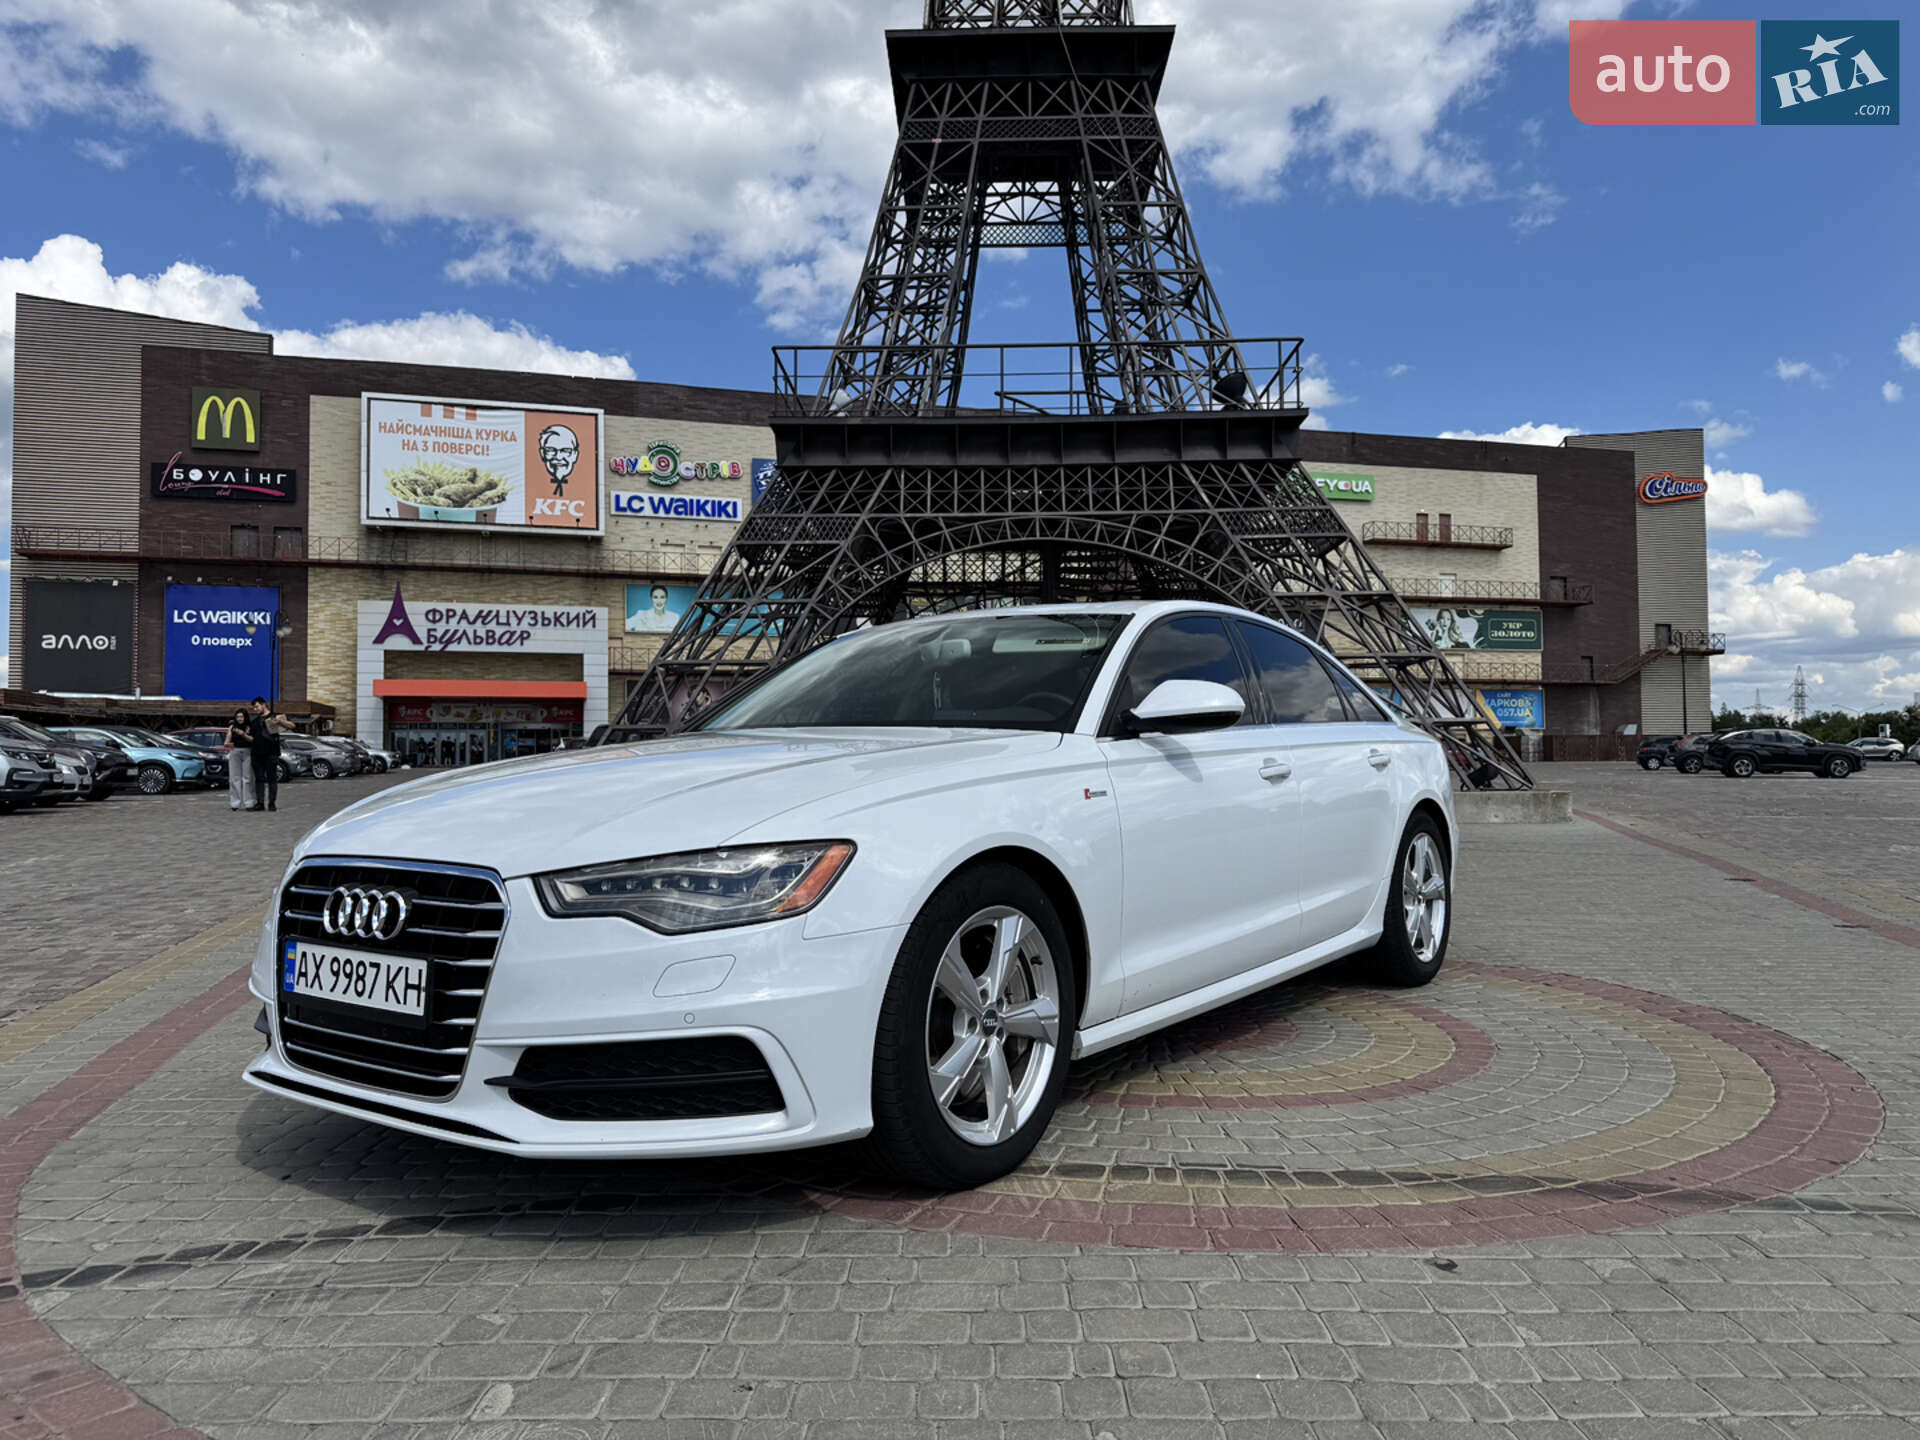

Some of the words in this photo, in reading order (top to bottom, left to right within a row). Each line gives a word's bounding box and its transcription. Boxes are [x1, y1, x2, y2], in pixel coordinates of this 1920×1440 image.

[378, 419, 474, 440] НАЙСМАЧНІША
[476, 428, 518, 442] КУРКА
[401, 439, 419, 452] НА
[421, 440, 429, 452] 3
[432, 441, 491, 456] ПОВЕРСІ!
[172, 468, 287, 485] БОУЛІНГ
[532, 498, 585, 517] KFC
[614, 494, 645, 513] LC
[173, 609, 198, 624] LC
[424, 607, 597, 629] ФРАНЦУЗЬКИЙ
[202, 636, 252, 649] поверх
[1491, 630, 1535, 638] ЗОЛОТО
[296, 951, 326, 991] AX
[329, 956, 381, 999] 9987
[385, 964, 423, 1007] KH
